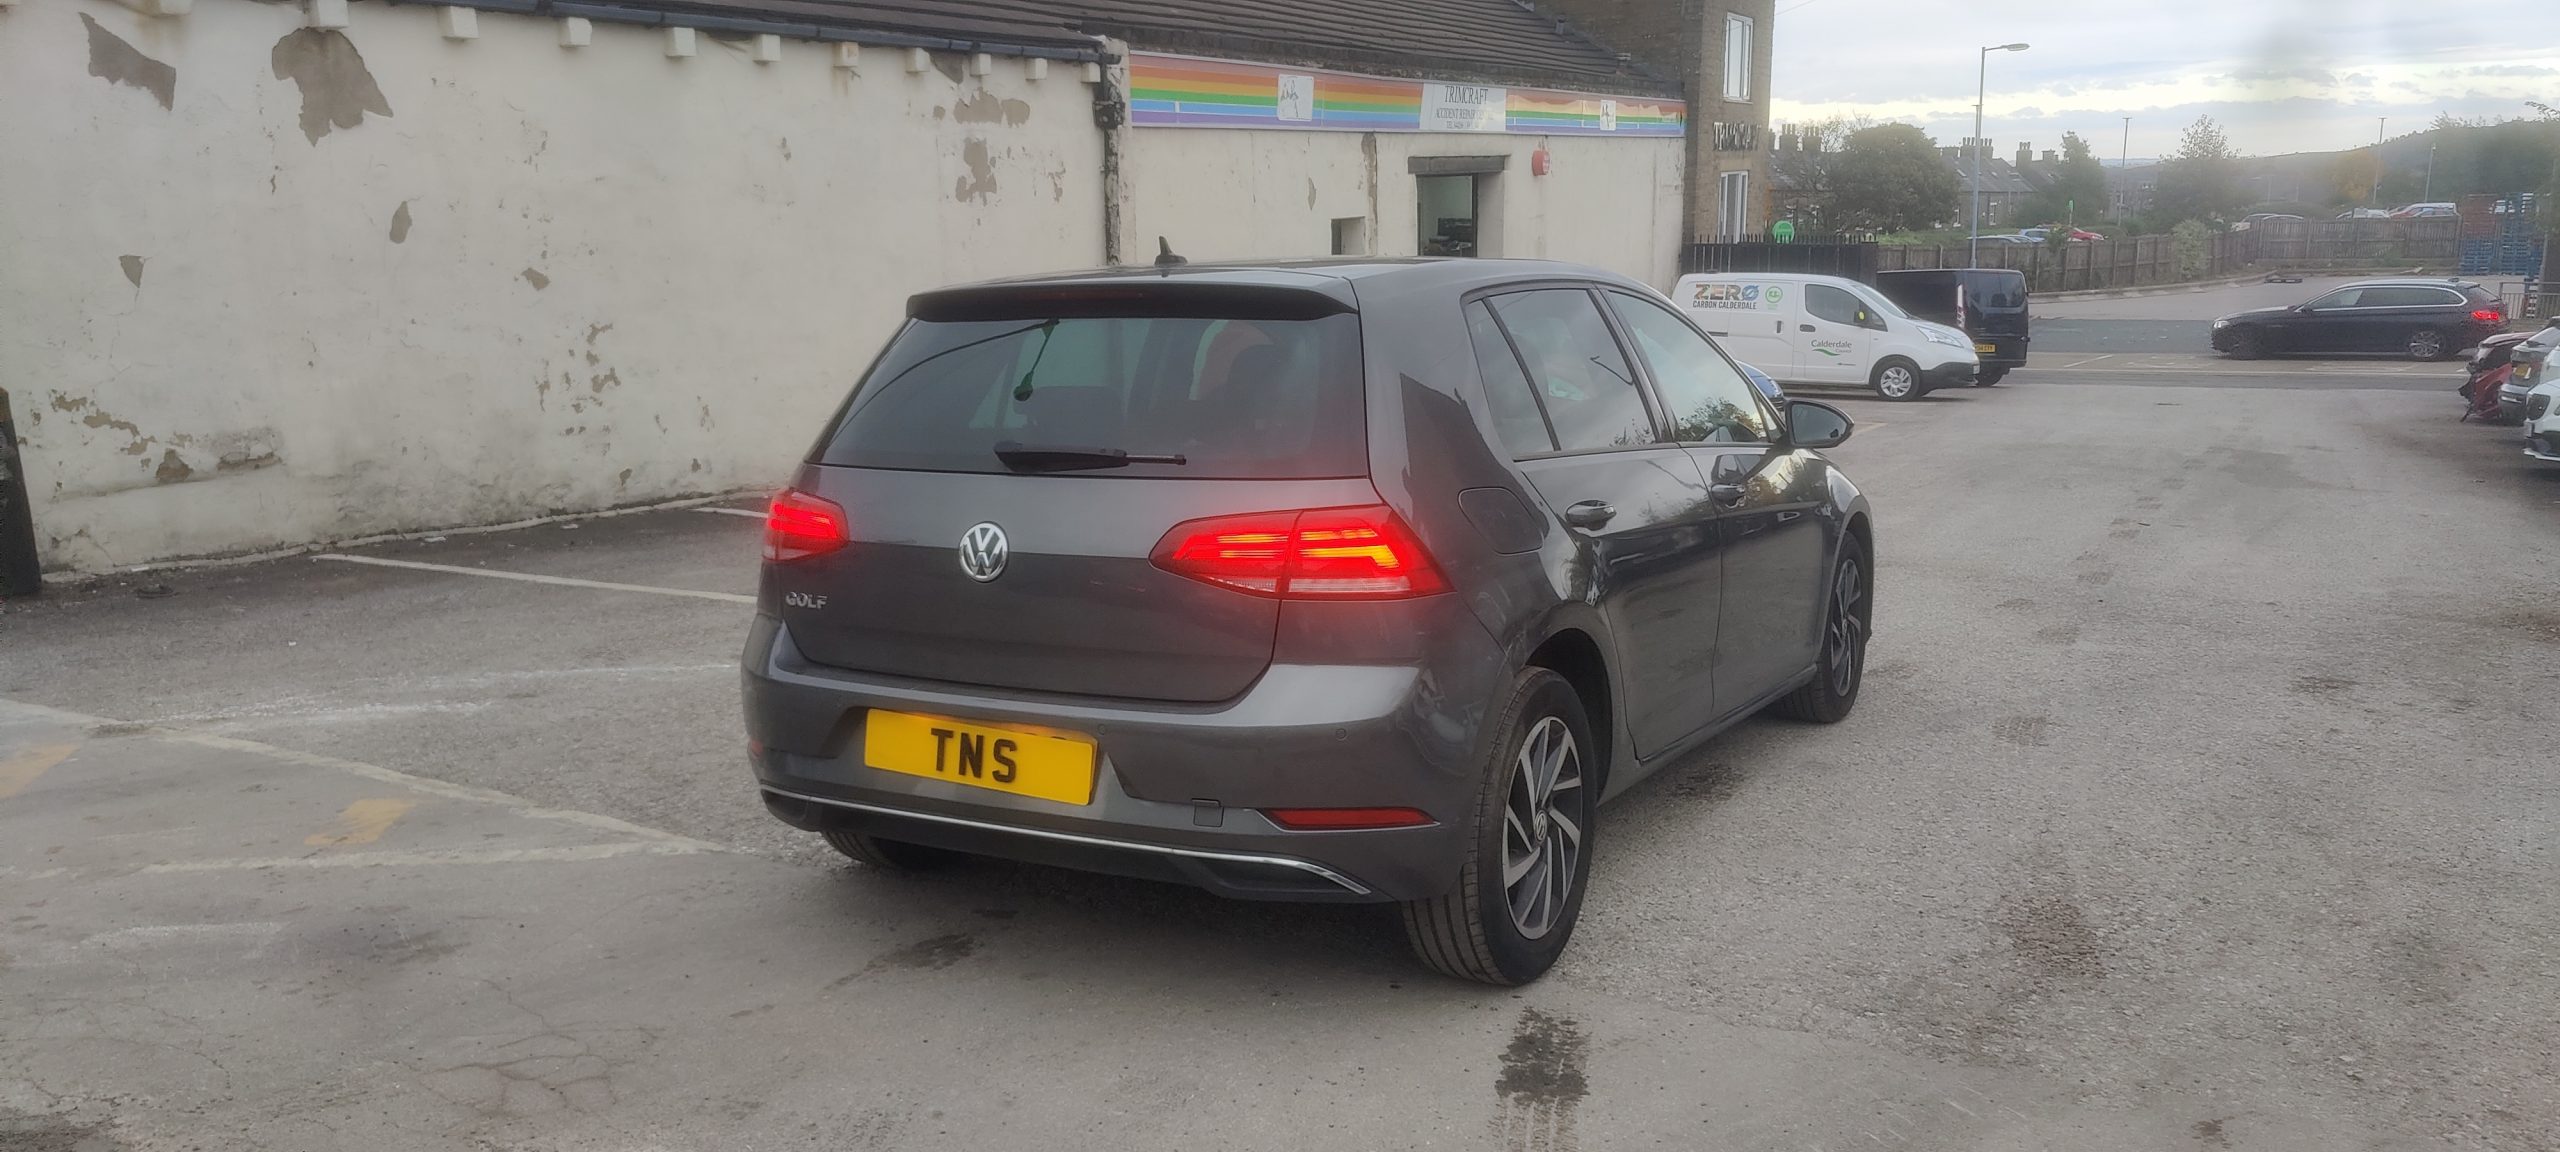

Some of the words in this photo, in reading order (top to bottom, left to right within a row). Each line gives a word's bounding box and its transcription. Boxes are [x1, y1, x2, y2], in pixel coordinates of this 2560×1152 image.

[1445, 85, 1489, 105] TRIMCRAFT
[1693, 283, 1760, 301] ZERO
[1692, 300, 1717, 309] CARBON
[1718, 301, 1757, 310] CALDERDALE
[1811, 339, 1852, 348] Calderdale
[785, 591, 828, 609] GOLF
[931, 727, 1018, 783] TNS
